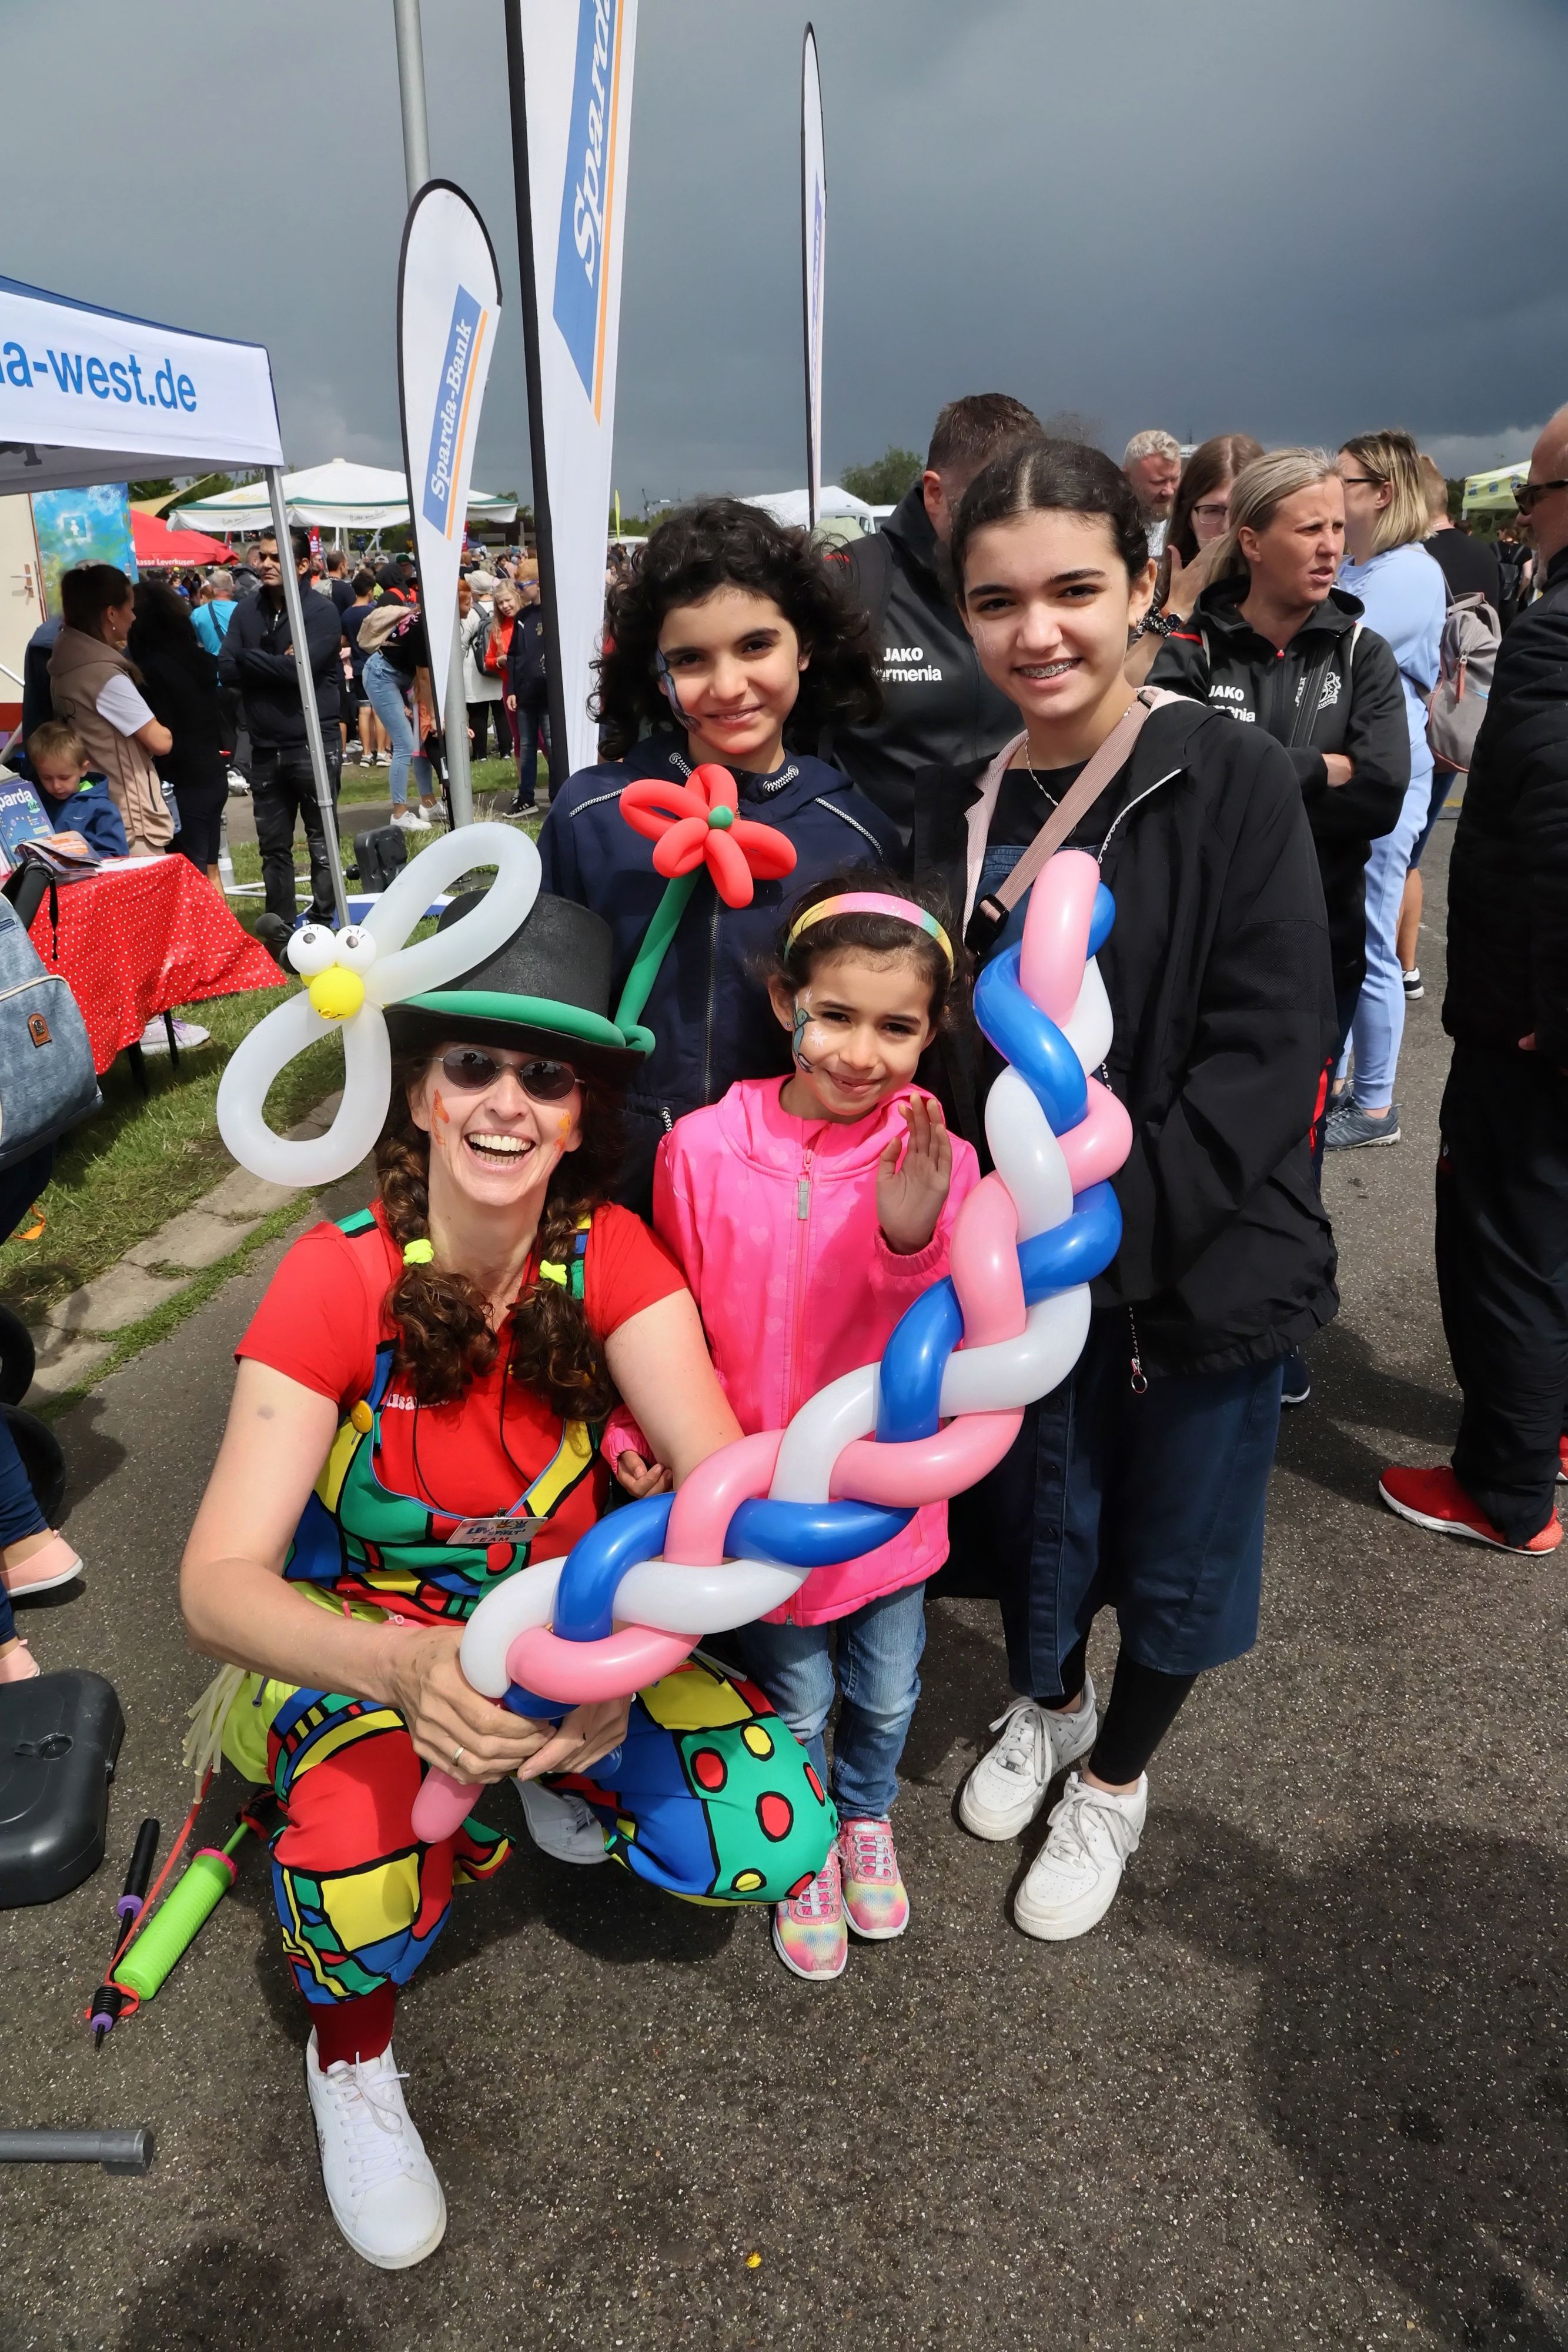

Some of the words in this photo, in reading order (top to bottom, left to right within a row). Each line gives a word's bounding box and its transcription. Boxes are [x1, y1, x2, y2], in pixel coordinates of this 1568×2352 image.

[0, 341, 197, 413] a-west.de
[431, 318, 472, 502] Sparda-Bank
[884, 647, 924, 662] JAKO
[1208, 685, 1245, 701] JAKO
